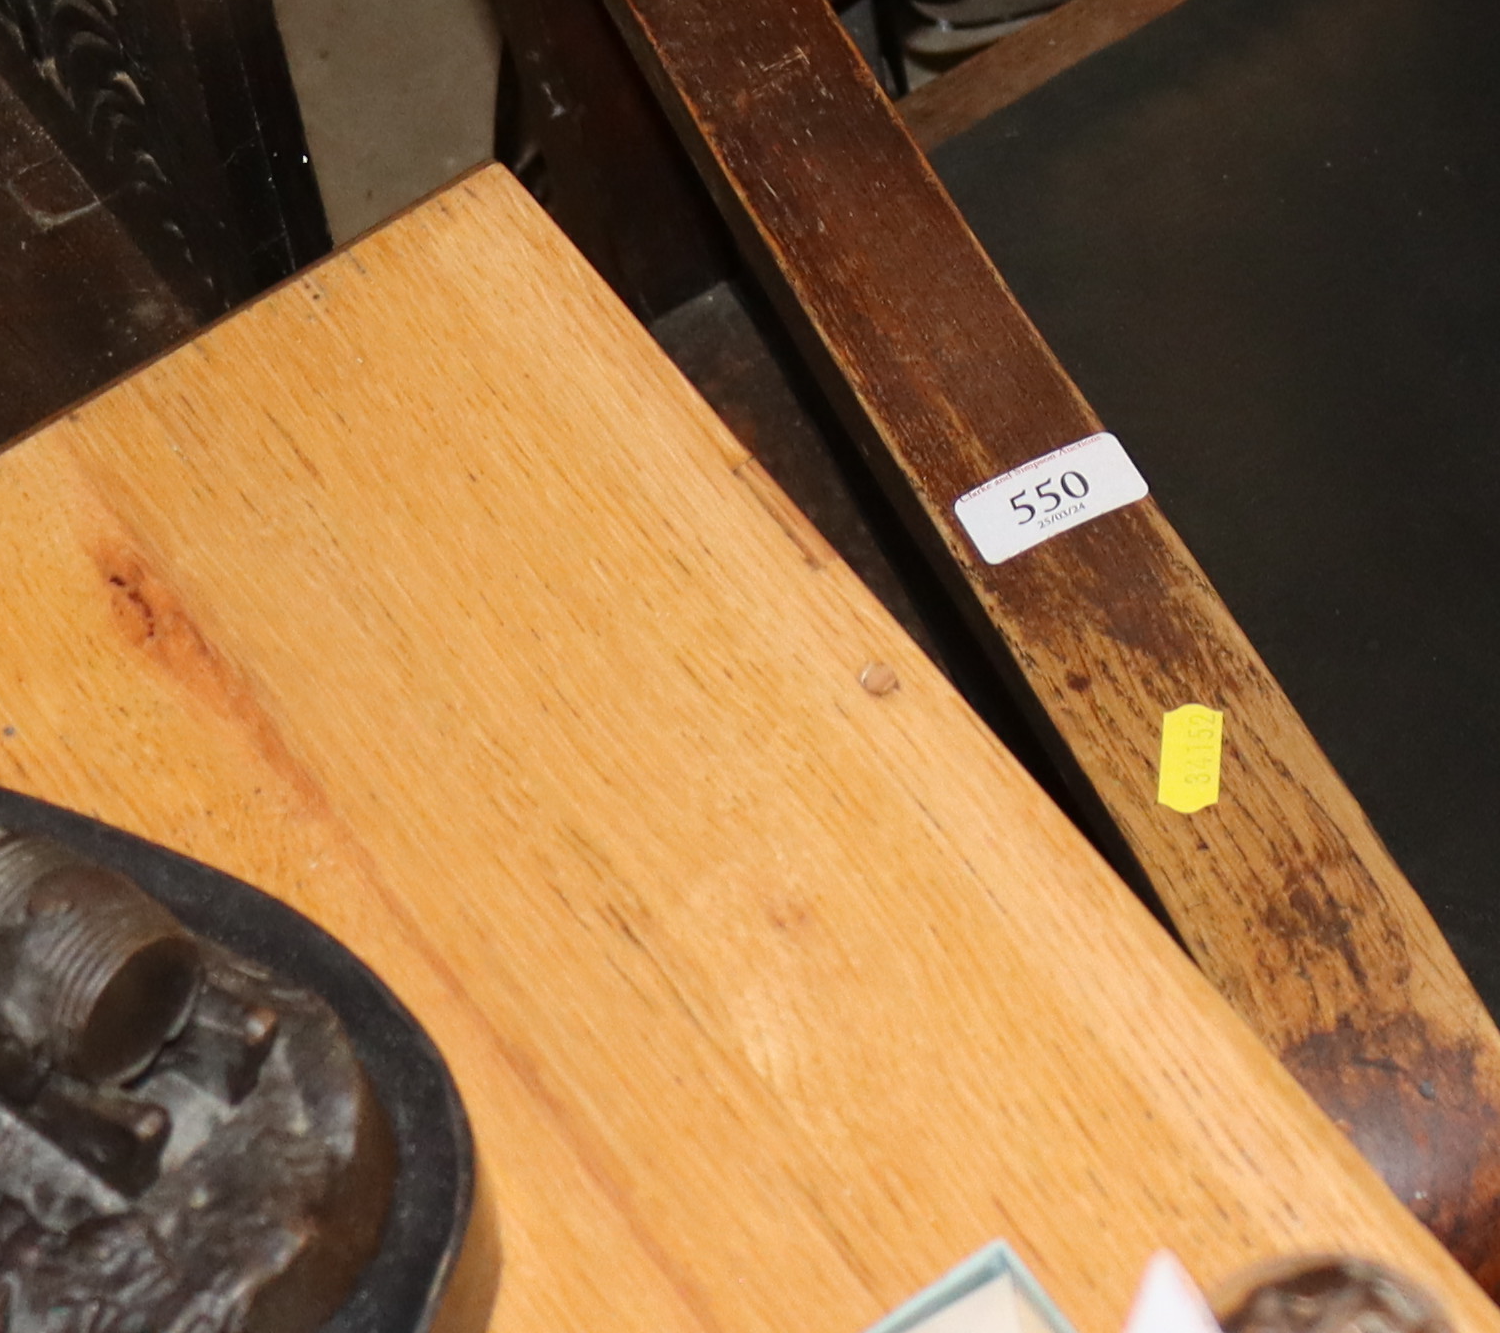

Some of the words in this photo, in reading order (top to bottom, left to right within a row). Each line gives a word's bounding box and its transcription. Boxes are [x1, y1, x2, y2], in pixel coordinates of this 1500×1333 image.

[960, 482, 992, 504] Clarke
[1014, 452, 1057, 477] Simpson
[1010, 470, 1090, 525] 550
[1038, 502, 1086, 531] 25/03/24
[1184, 713, 1216, 784] 34152
